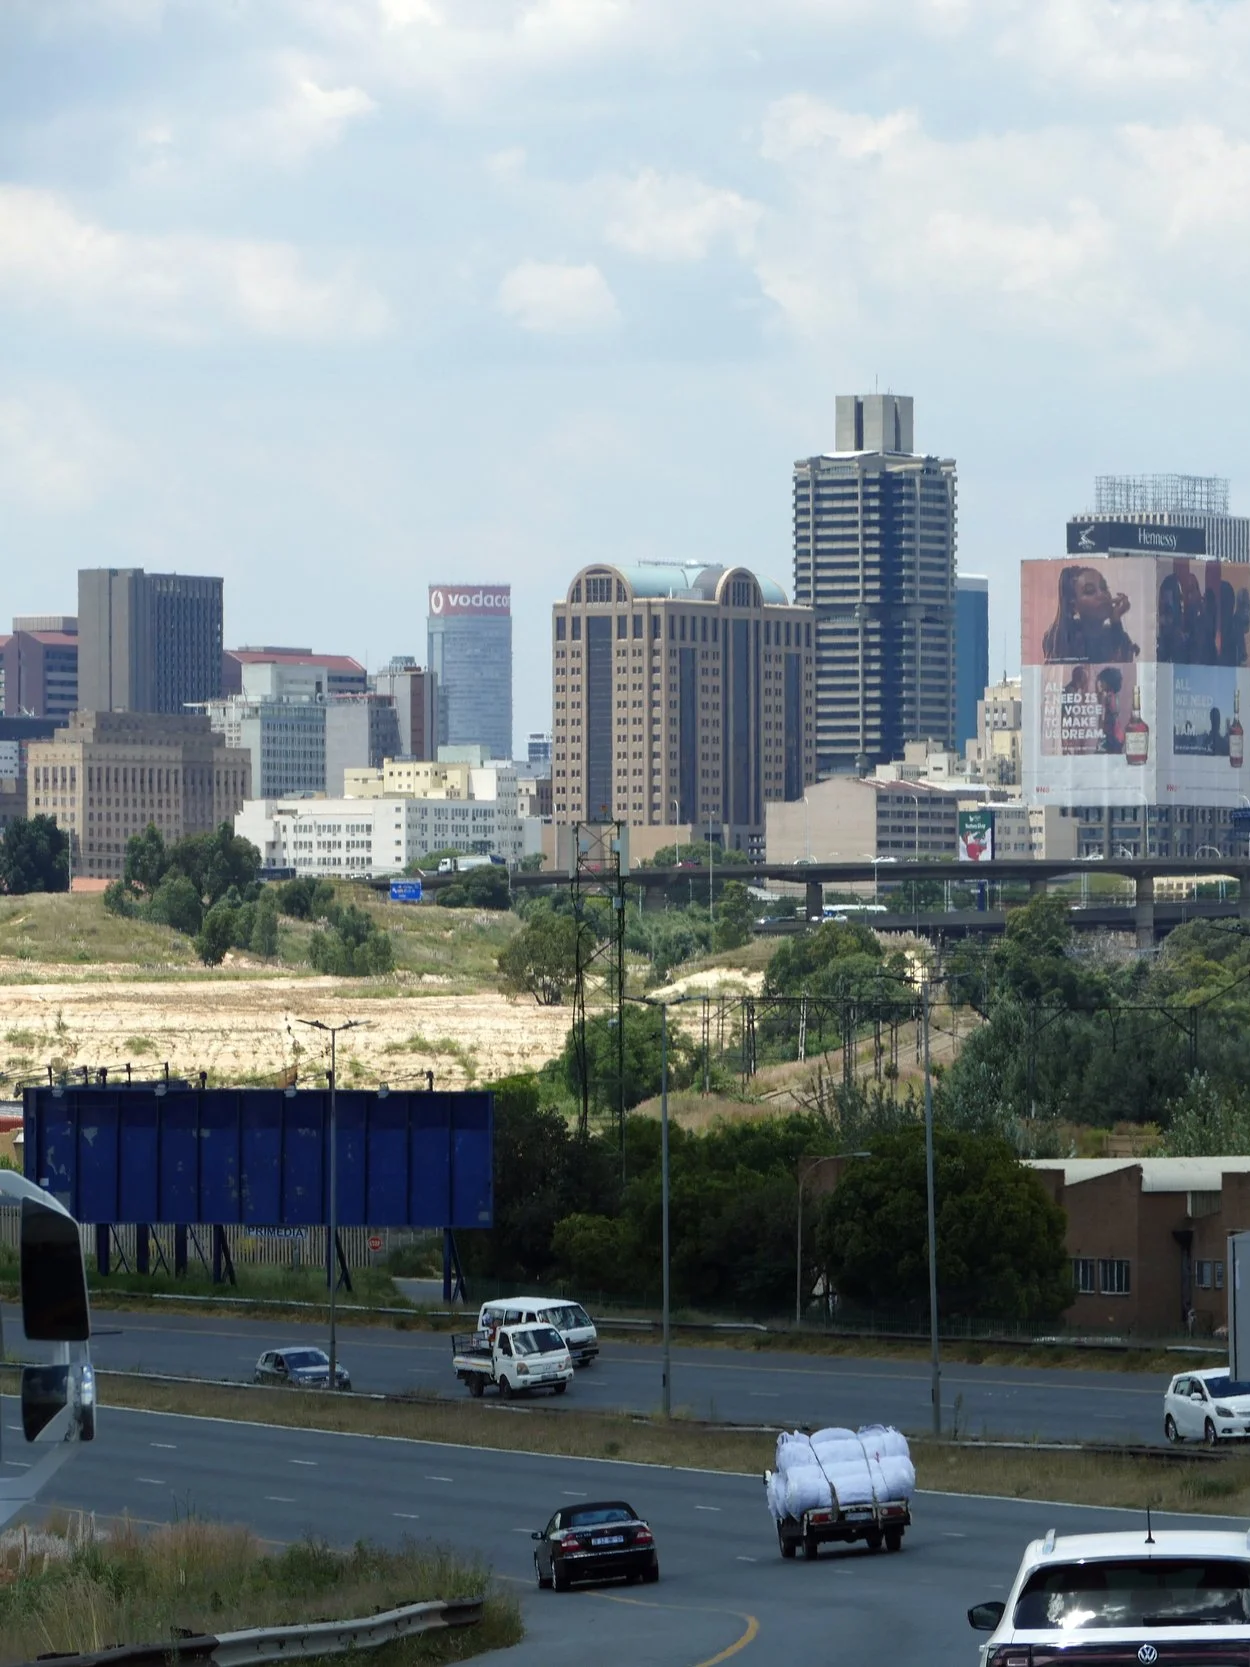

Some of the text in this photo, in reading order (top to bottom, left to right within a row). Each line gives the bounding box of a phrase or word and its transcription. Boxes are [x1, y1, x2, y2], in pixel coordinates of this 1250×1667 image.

[1138, 527, 1177, 550] Hennessy
[447, 590, 510, 608] vodaco
[1045, 682, 1066, 692] ALL
[1053, 692, 1082, 704] NEED
[1085, 693, 1098, 703] IS
[1064, 704, 1103, 715] VOICE
[1045, 716, 1097, 727] TO MAKE
[1062, 728, 1106, 739] DREAM.
[248, 1226, 304, 1238] PRIMEDIA
